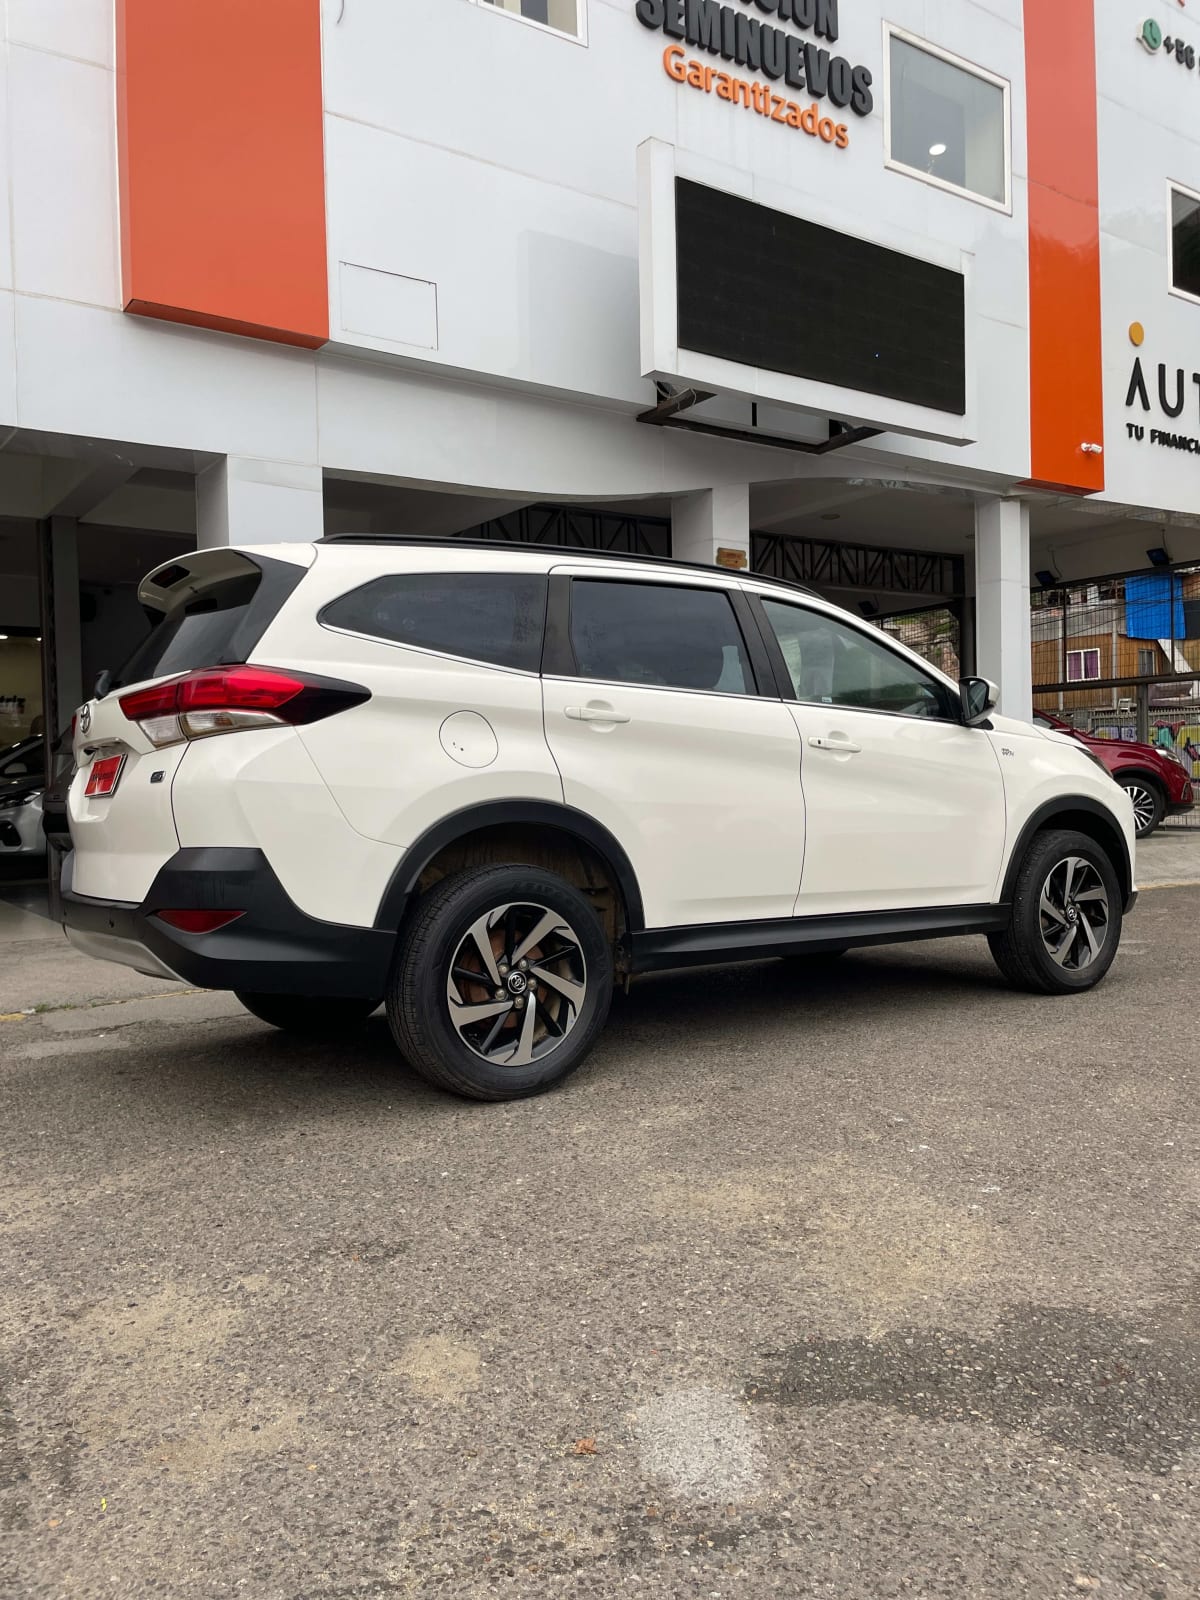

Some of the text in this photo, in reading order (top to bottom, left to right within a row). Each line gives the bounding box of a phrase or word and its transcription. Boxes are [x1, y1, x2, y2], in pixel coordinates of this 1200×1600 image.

[636, 0, 874, 116] SEMINUEVOS
[662, 44, 849, 148] Garantizados
[1126, 422, 1144, 441] TU
